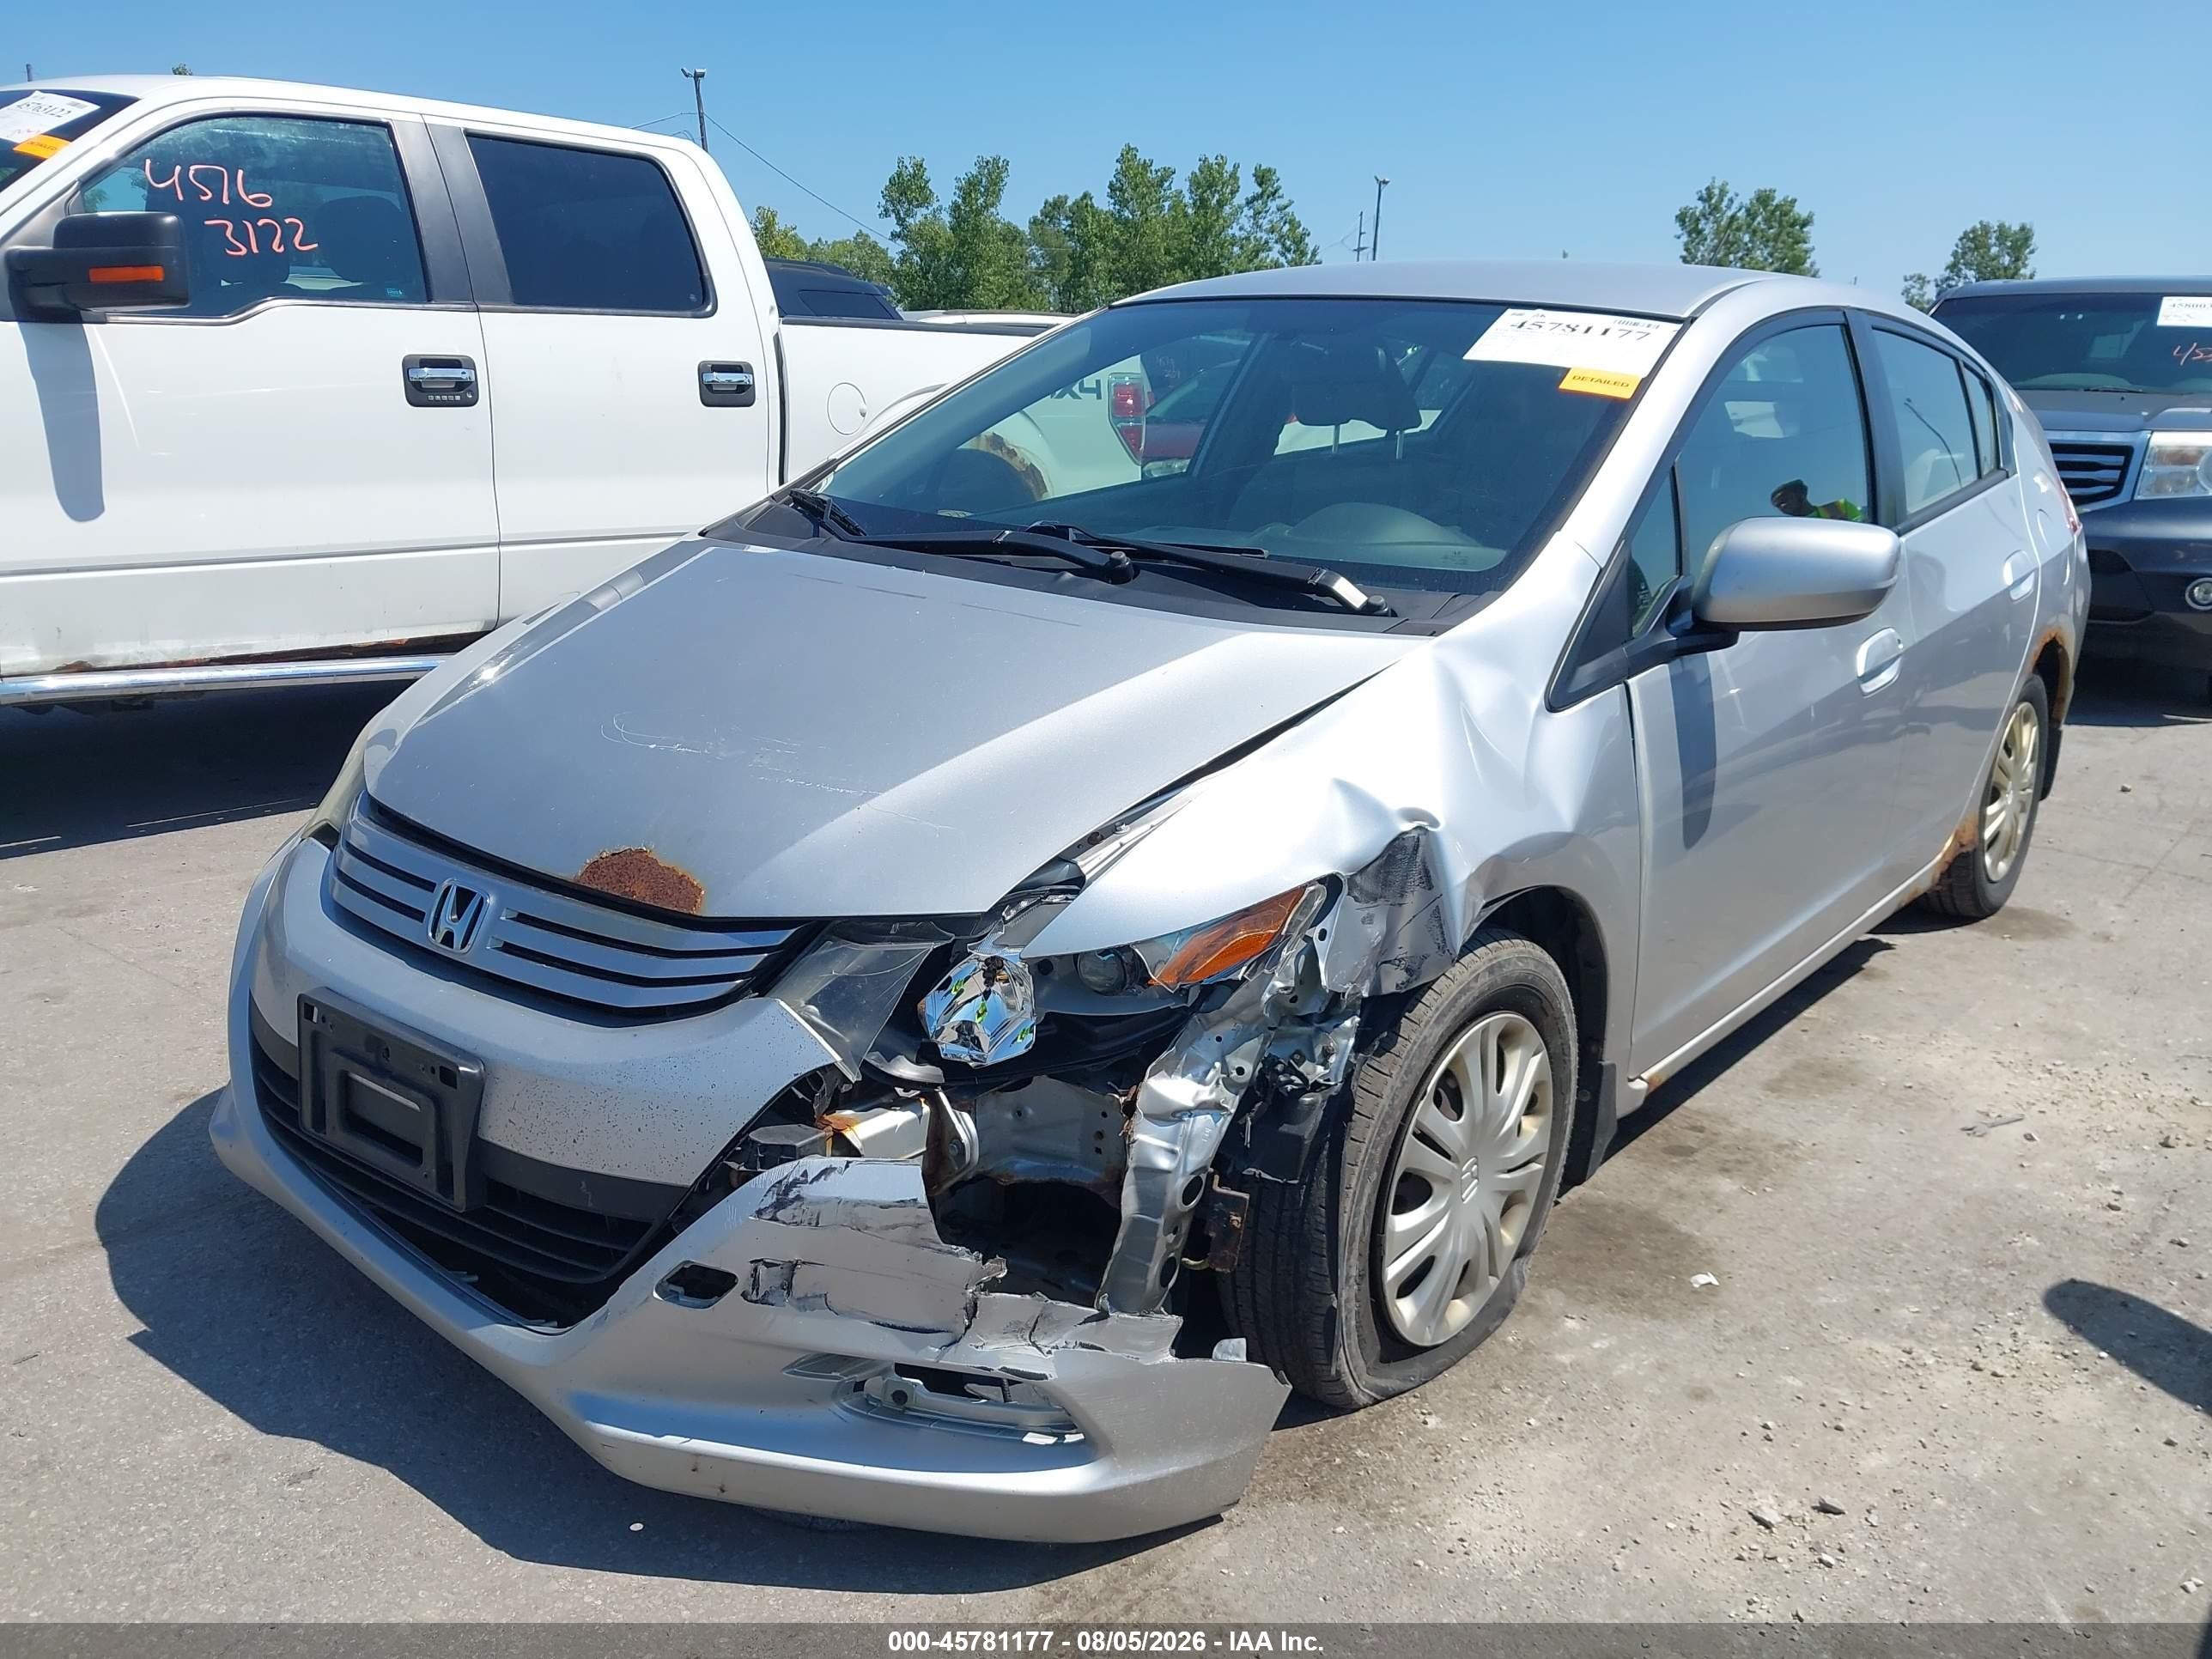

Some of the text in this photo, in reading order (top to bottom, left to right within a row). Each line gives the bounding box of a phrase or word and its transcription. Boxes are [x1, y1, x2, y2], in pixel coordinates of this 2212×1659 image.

[204, 217, 319, 256] 3122
[1510, 320, 1651, 341] 45781177
[1572, 374, 1630, 387] DETAILED
